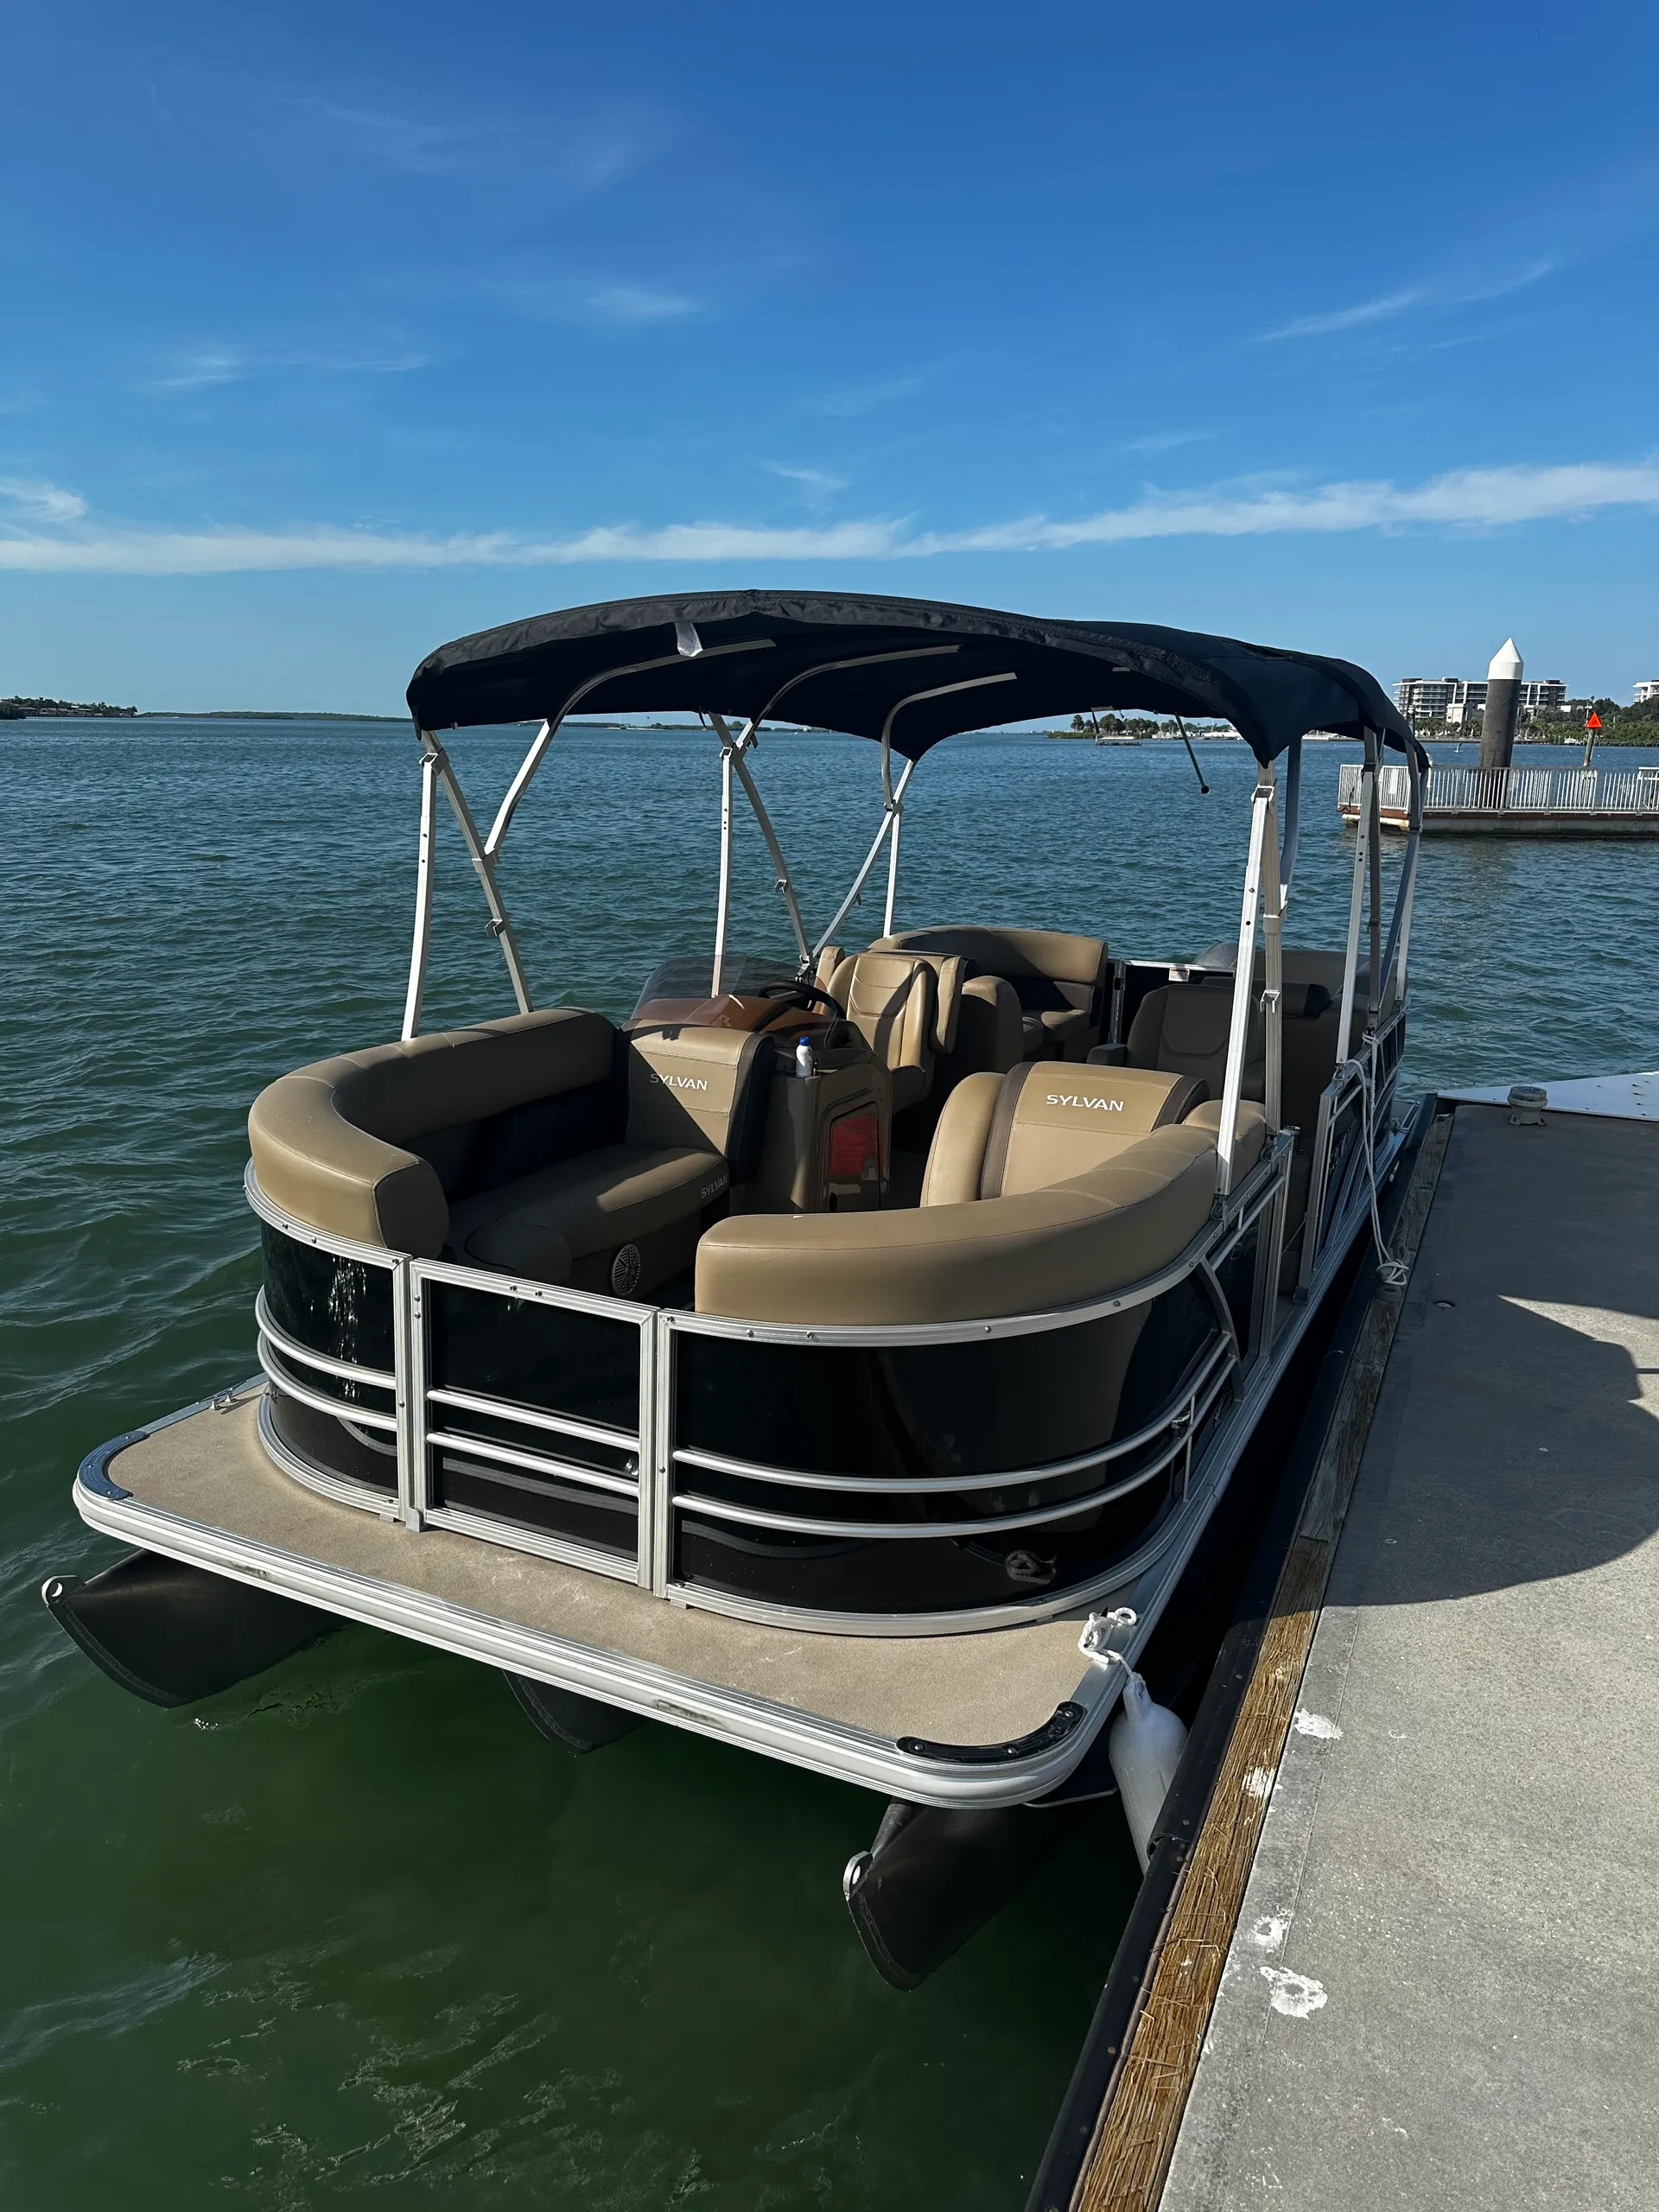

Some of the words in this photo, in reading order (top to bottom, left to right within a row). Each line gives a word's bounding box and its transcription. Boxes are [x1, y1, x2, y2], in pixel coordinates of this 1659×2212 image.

[650, 1073, 708, 1091] SYLVAN
[1046, 1094, 1124, 1112] SYLVAN
[701, 1173, 728, 1198] SYLVAN
